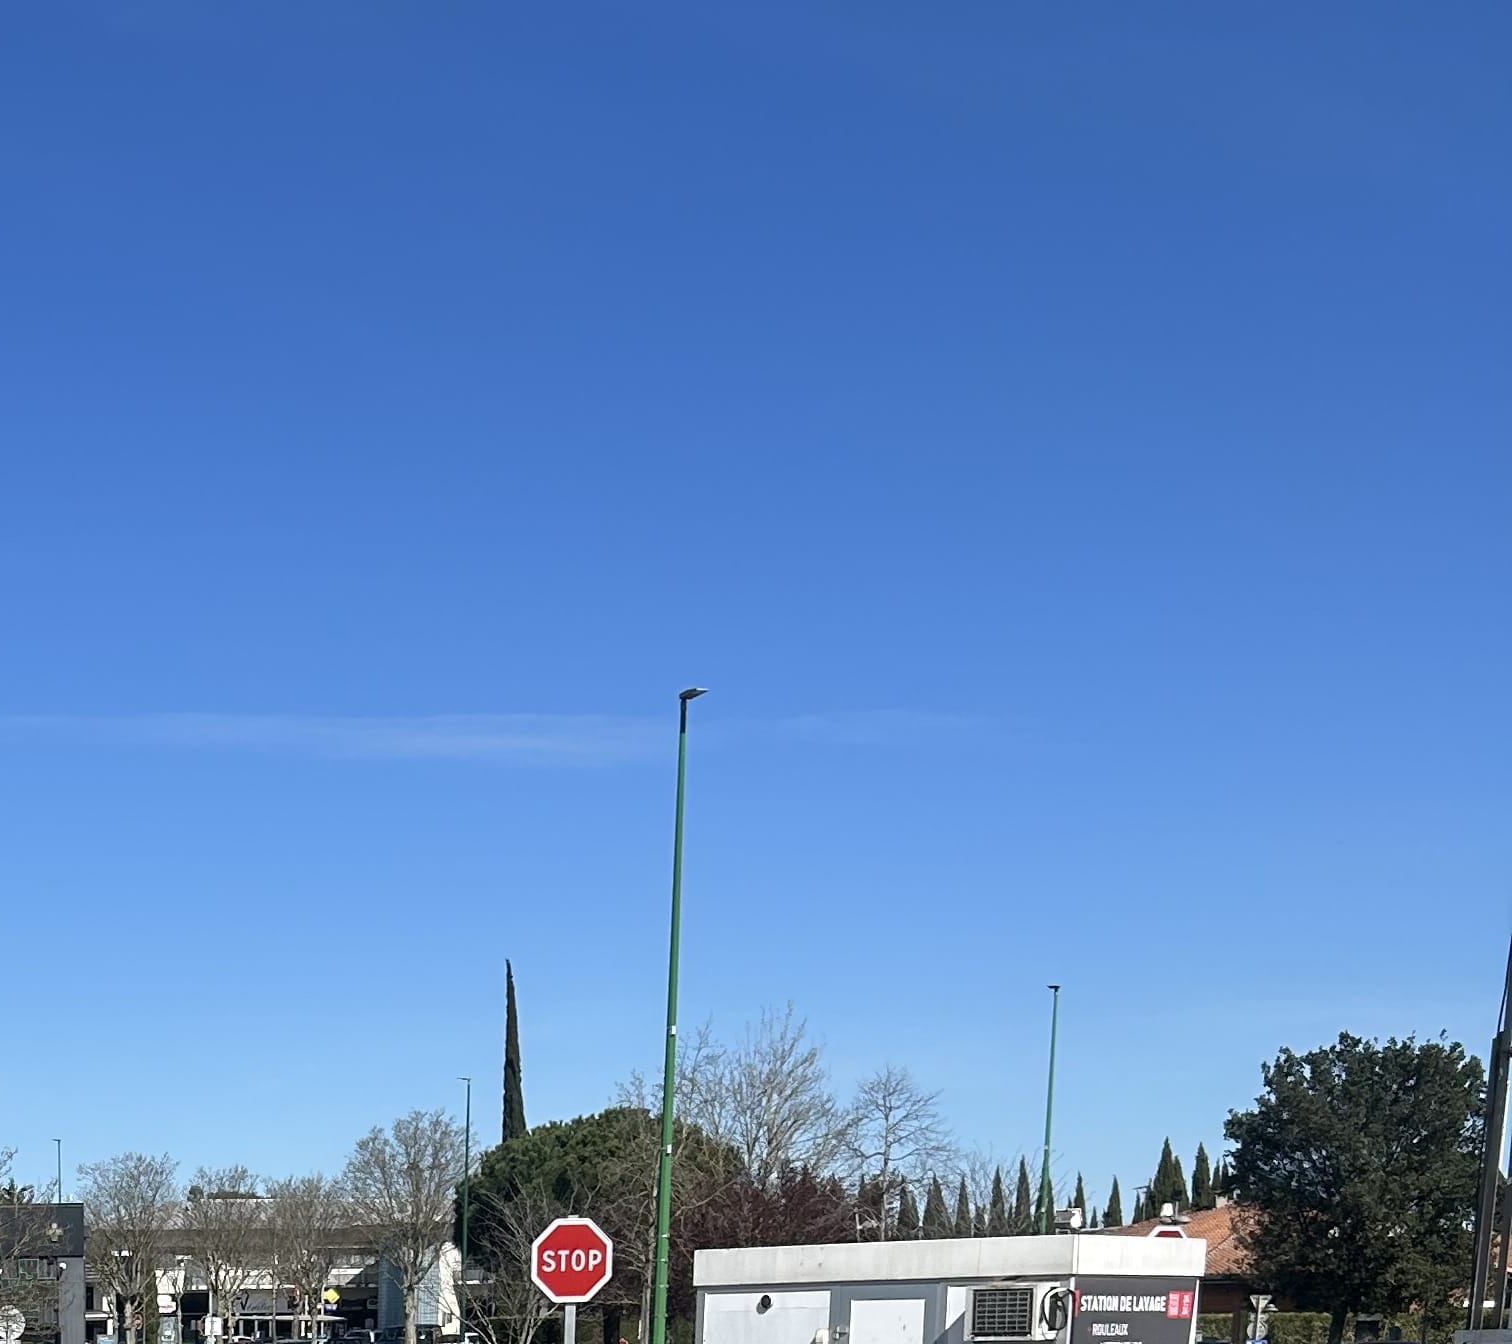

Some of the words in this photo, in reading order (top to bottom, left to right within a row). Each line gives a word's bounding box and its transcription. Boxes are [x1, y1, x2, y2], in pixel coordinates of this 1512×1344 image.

[541, 1249, 602, 1273] STOP
[1080, 1295, 1118, 1312] STATION
[1119, 1295, 1133, 1312] DE
[1133, 1295, 1167, 1312] LAVAGE
[1092, 1323, 1128, 1336] ROULEAUX
